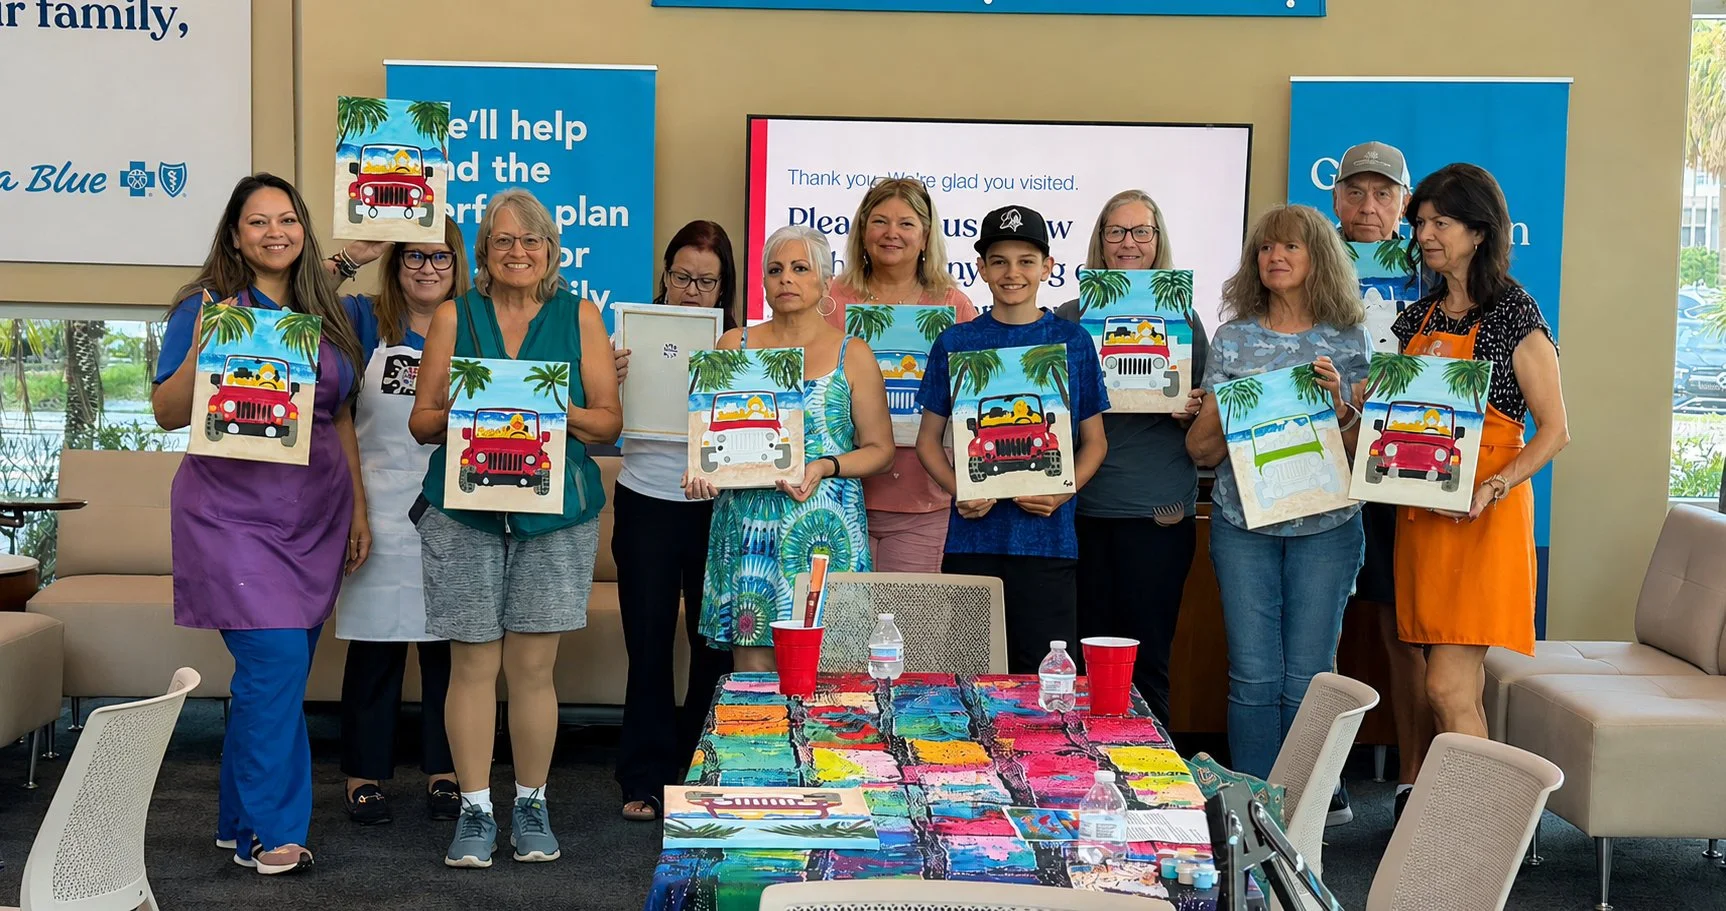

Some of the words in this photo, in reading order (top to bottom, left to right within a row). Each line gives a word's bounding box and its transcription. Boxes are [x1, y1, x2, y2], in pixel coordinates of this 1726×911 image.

[36, 0, 189, 41] family,
[448, 109, 497, 139] e'll
[511, 109, 588, 150] help
[25, 160, 107, 194] Blue
[491, 152, 551, 183] the
[788, 169, 841, 186] Thank
[941, 173, 978, 192] glad
[984, 176, 1015, 192] you
[1020, 175, 1079, 191] visited.
[555, 195, 630, 234] plan
[788, 207, 850, 235] Plea
[943, 218, 978, 238] us
